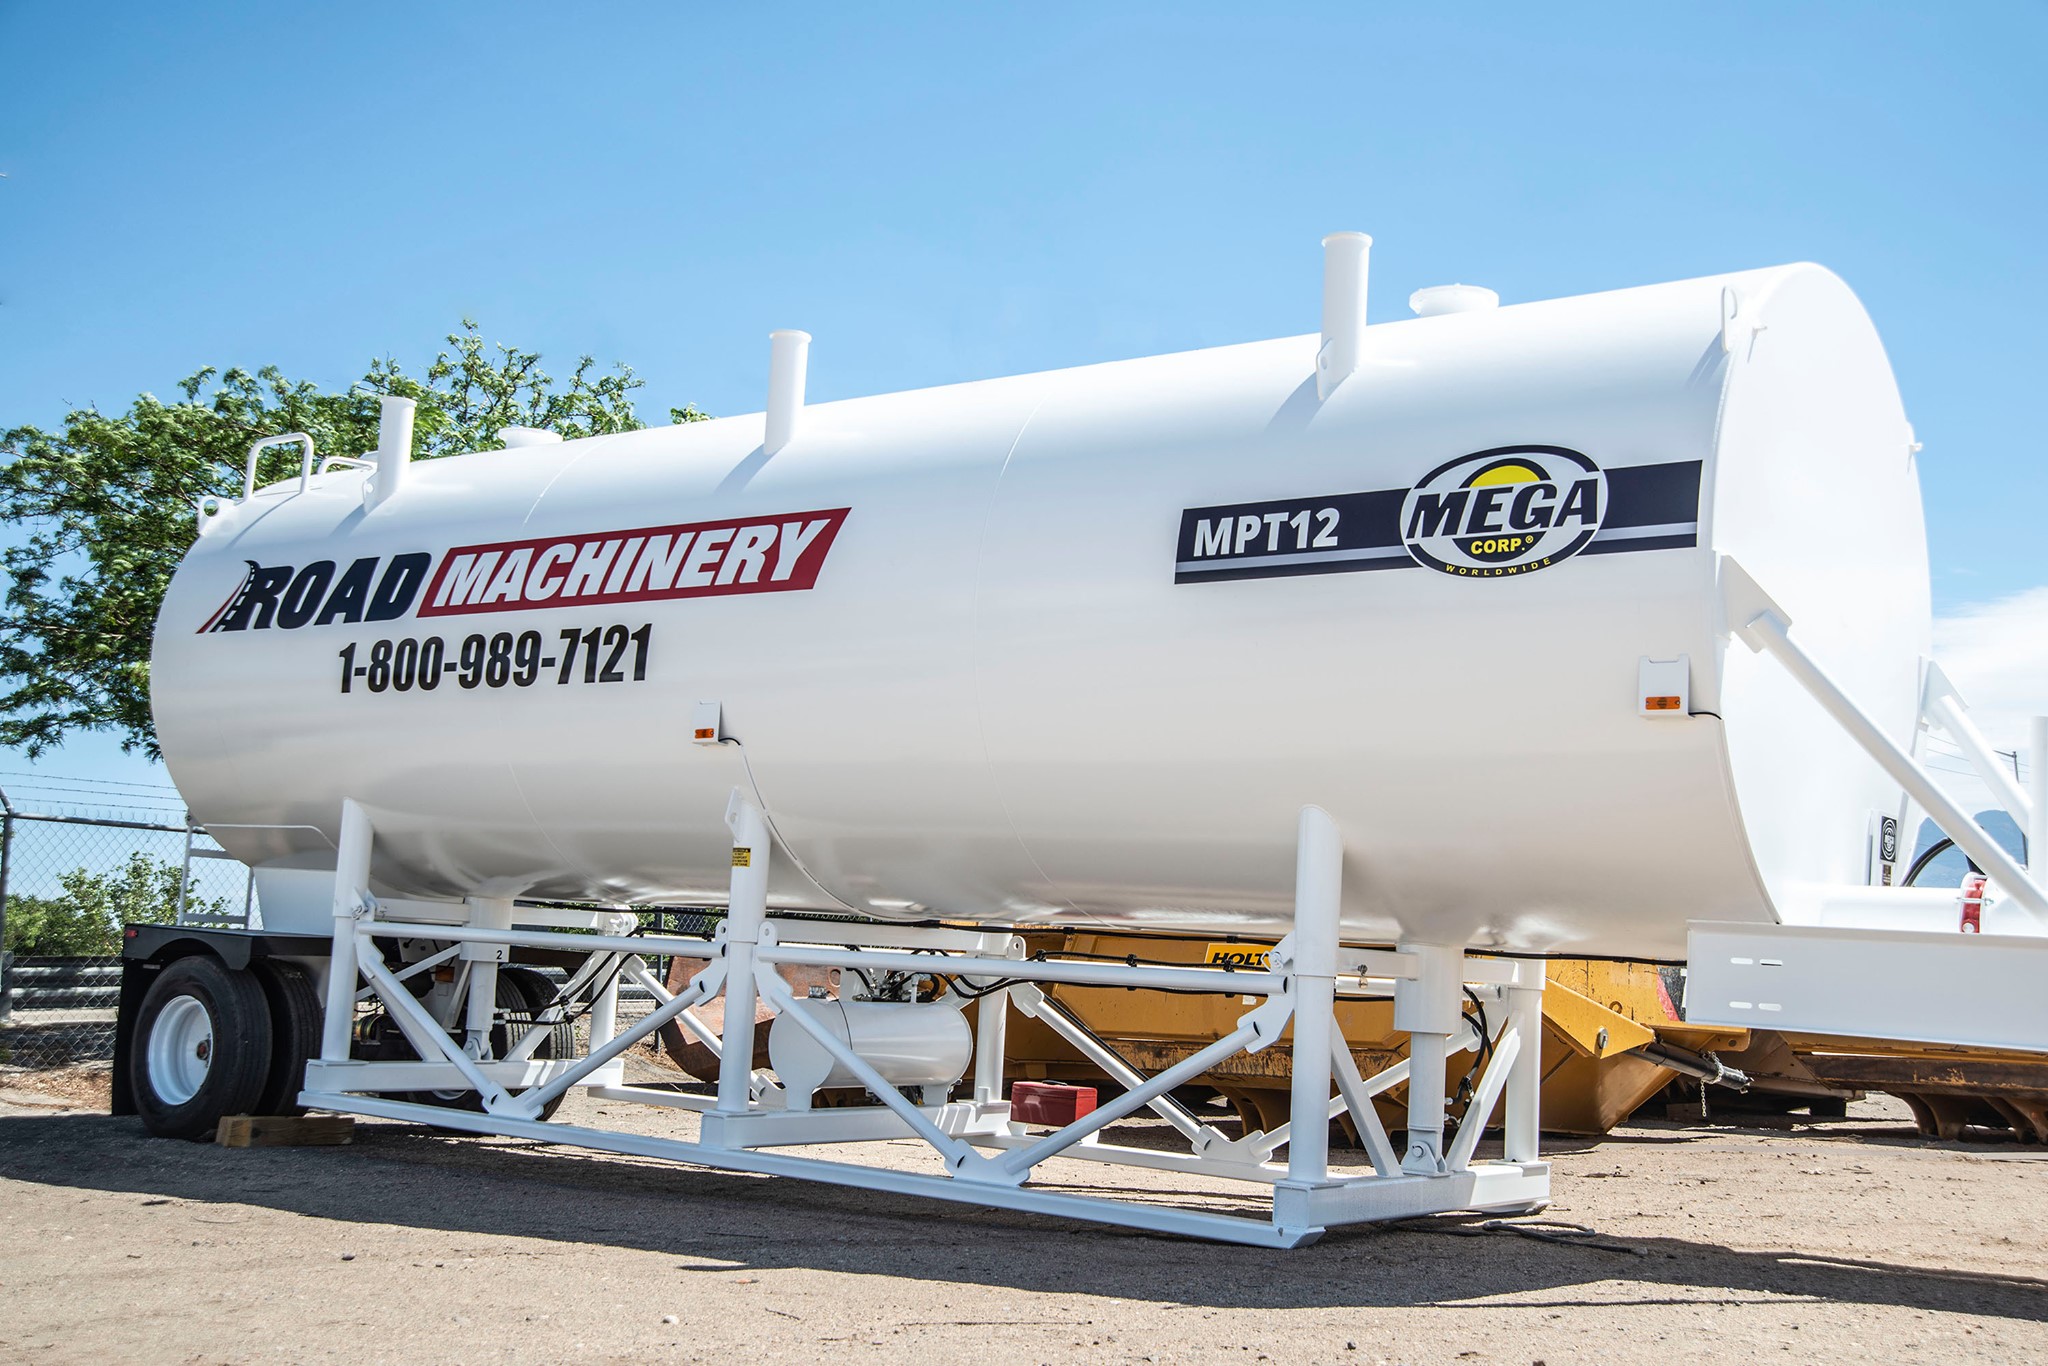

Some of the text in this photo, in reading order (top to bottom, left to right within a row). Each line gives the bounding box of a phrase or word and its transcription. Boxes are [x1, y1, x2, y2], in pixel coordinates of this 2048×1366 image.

[1193, 506, 1341, 557] MPT12
[1405, 478, 1598, 538] MEGA
[209, 518, 833, 632] ROAD MACHINERY
[1445, 557, 1551, 576] WORLDWIDE
[338, 623, 652, 694] 1-800-989-7121
[496, 949, 503, 960] 2
